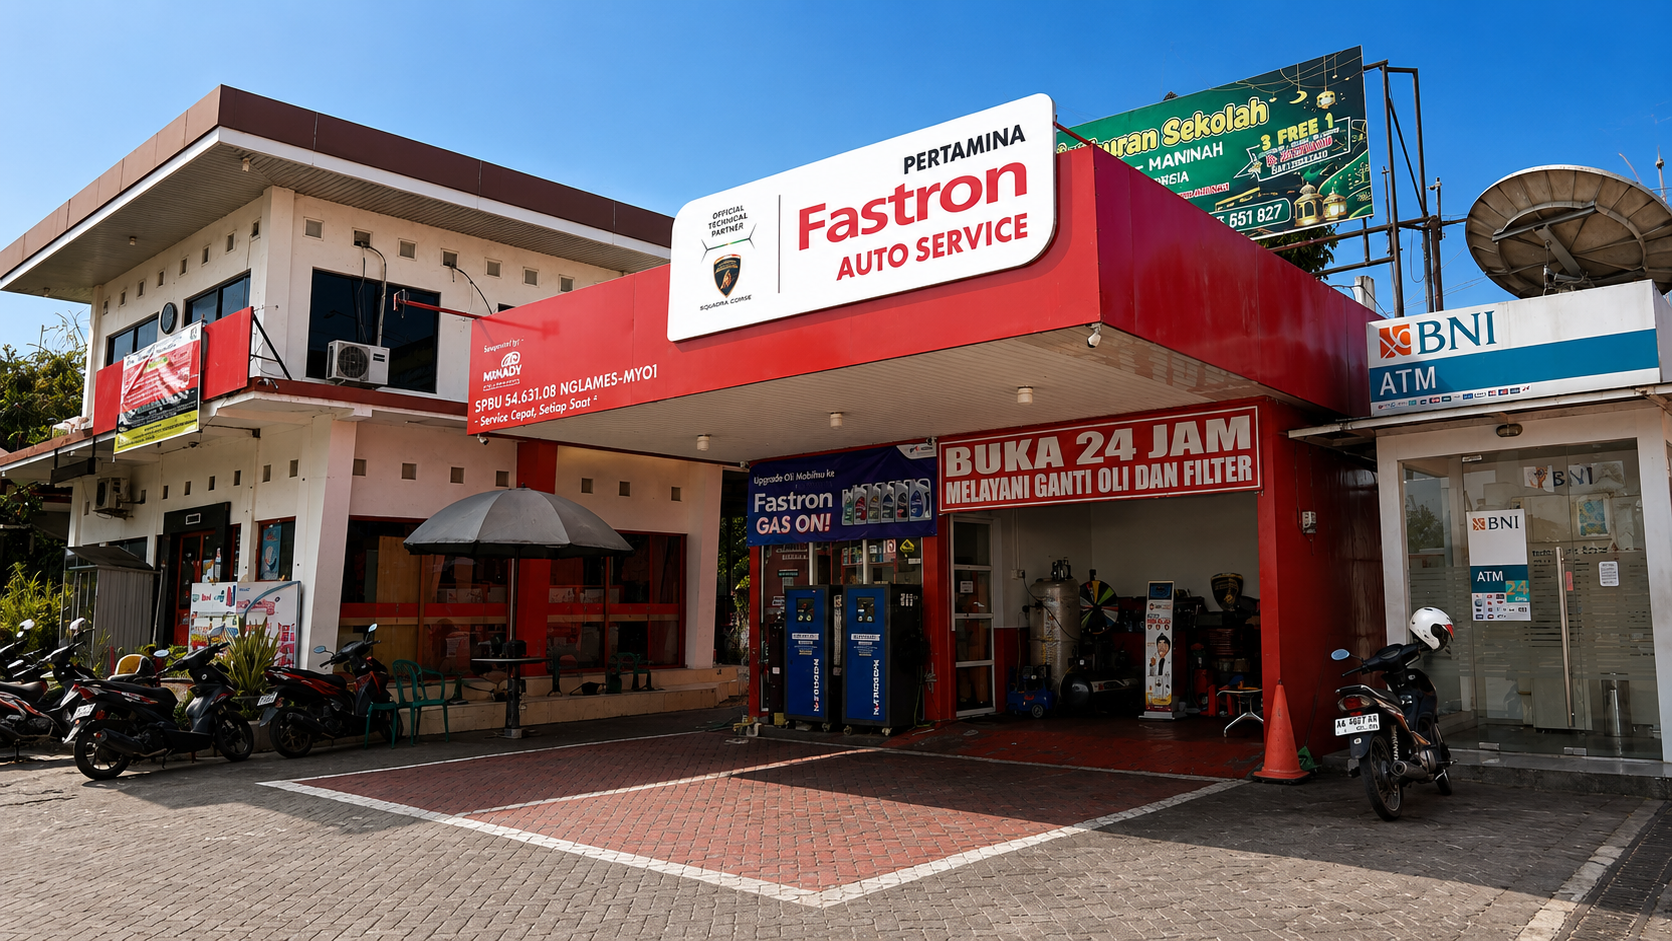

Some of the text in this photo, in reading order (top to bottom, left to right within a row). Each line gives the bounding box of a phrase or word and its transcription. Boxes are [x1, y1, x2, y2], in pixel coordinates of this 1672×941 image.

[1162, 97, 1269, 146] Sekolah
[1260, 134, 1271, 151] 3
[1277, 117, 1319, 145] FREE
[1325, 112, 1334, 129] 1
[904, 124, 1025, 175] PERTAMINA
[712, 205, 745, 220] OFFICIAL
[798, 161, 1027, 251] Fastron
[1229, 209, 1254, 229] 651
[1257, 204, 1283, 222] 827
[708, 212, 748, 230] TECHNICAL
[711, 222, 744, 238] PARTNER
[836, 212, 1028, 282] AUTO SERVICE
[1416, 310, 1497, 355] BNI
[1379, 365, 1437, 397] ATM
[475, 395, 502, 414] SPBU
[505, 384, 556, 407] 54.631.08
[480, 412, 508, 427] Service
[945, 414, 1251, 478] BUKA 24 JAM
[945, 454, 1253, 505] MELAYANI GANTI OLI DAN FILTER
[753, 491, 833, 513] Fastron
[756, 513, 832, 535] GAS ON!
[1488, 515, 1519, 530] BNI
[1477, 570, 1504, 582] ATM
[1506, 580, 1527, 596] 24
